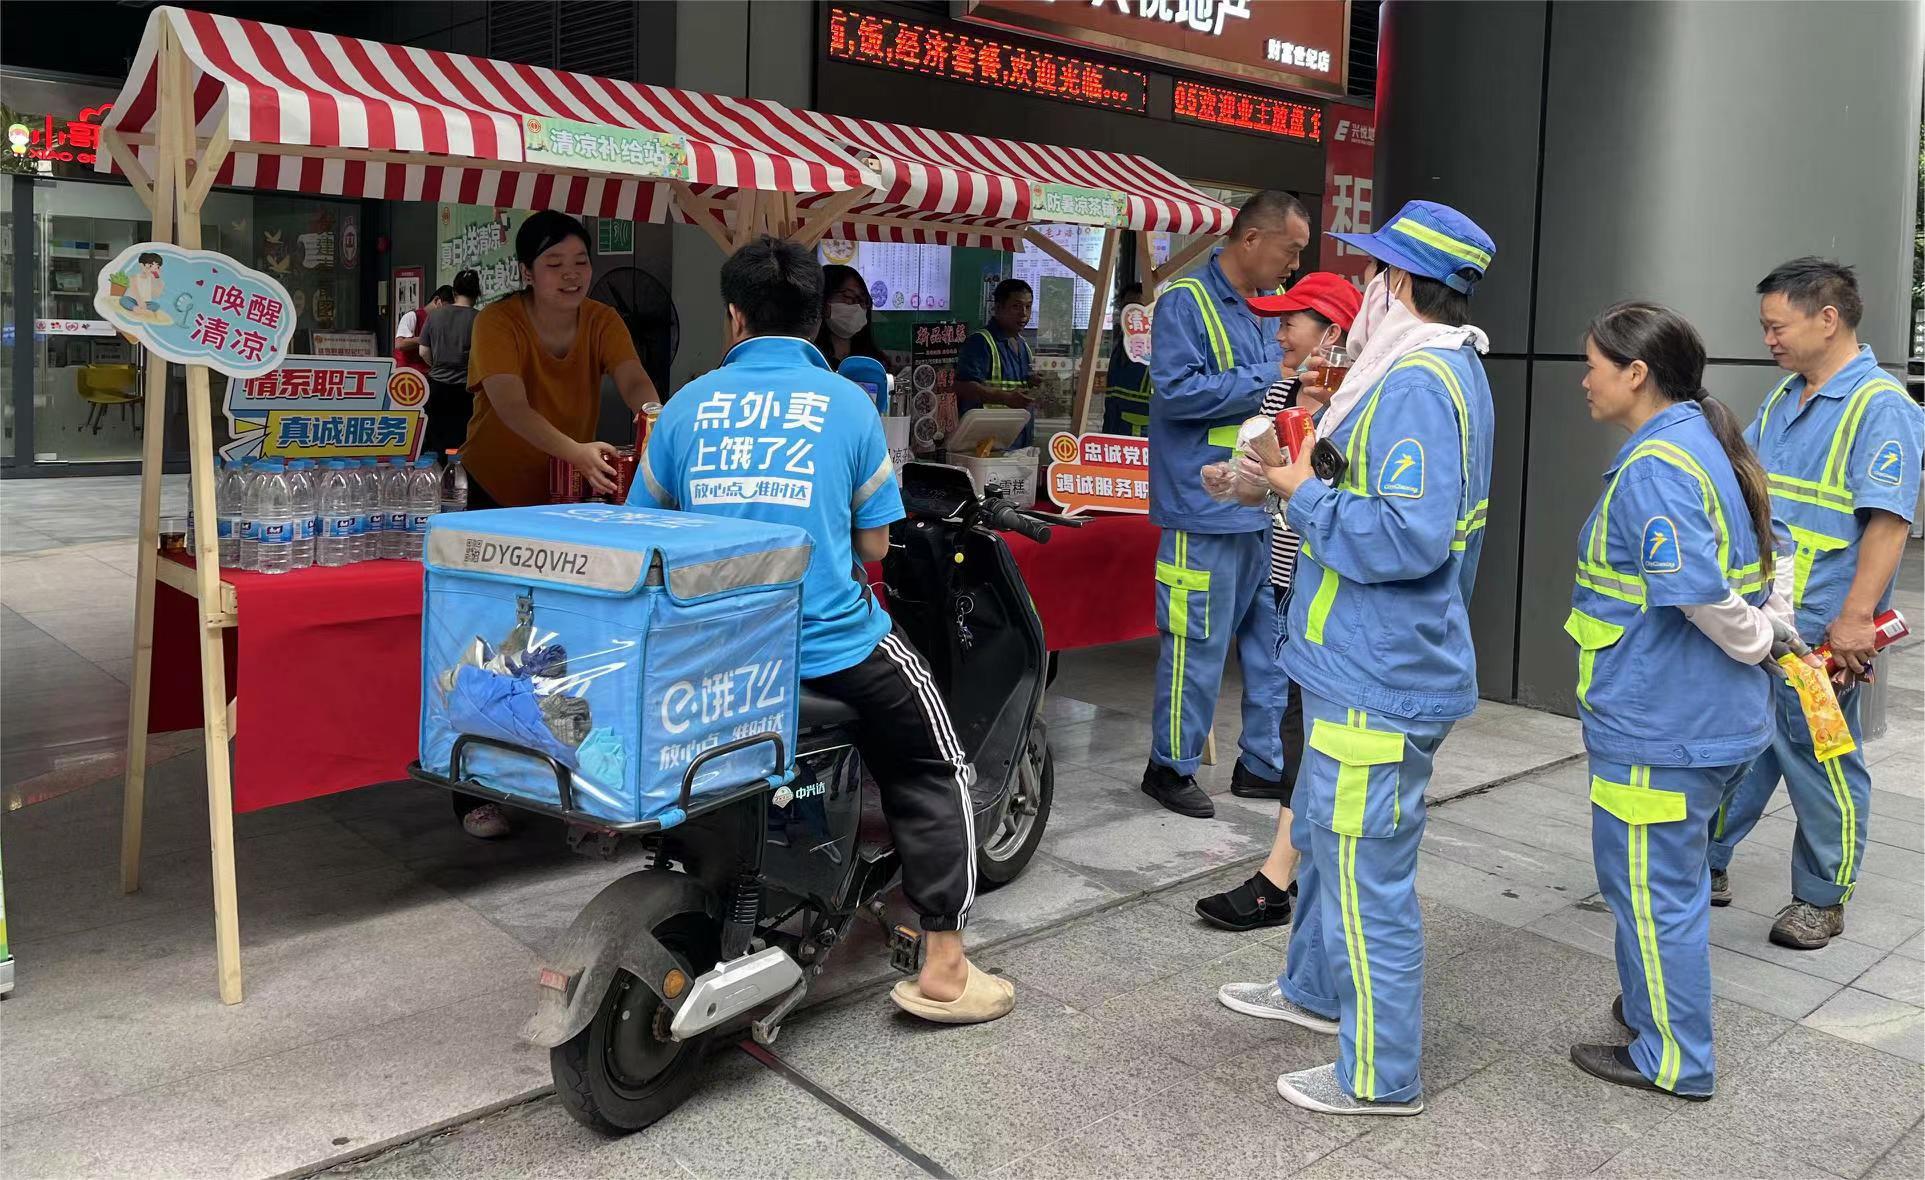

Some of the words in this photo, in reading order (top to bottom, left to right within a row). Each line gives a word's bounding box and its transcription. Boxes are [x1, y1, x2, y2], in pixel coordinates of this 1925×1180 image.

[1091, 0, 1251, 36] 地产
[1267, 38, 1331, 73] 财富世纪店
[28, 147, 74, 162] XIAO
[550, 128, 666, 167] 清凉补给站
[440, 221, 502, 272] 夏日送清凉
[211, 284, 283, 330] 唤醒
[190, 313, 268, 362] 清凉
[243, 368, 377, 399] 情系职工
[693, 390, 831, 433] 点外卖
[276, 416, 409, 448] 真诚服务
[689, 435, 816, 476] 上饿了么
[1056, 473, 1149, 499] 竭诚服务职
[481, 541, 589, 577] DYG2QVH2
